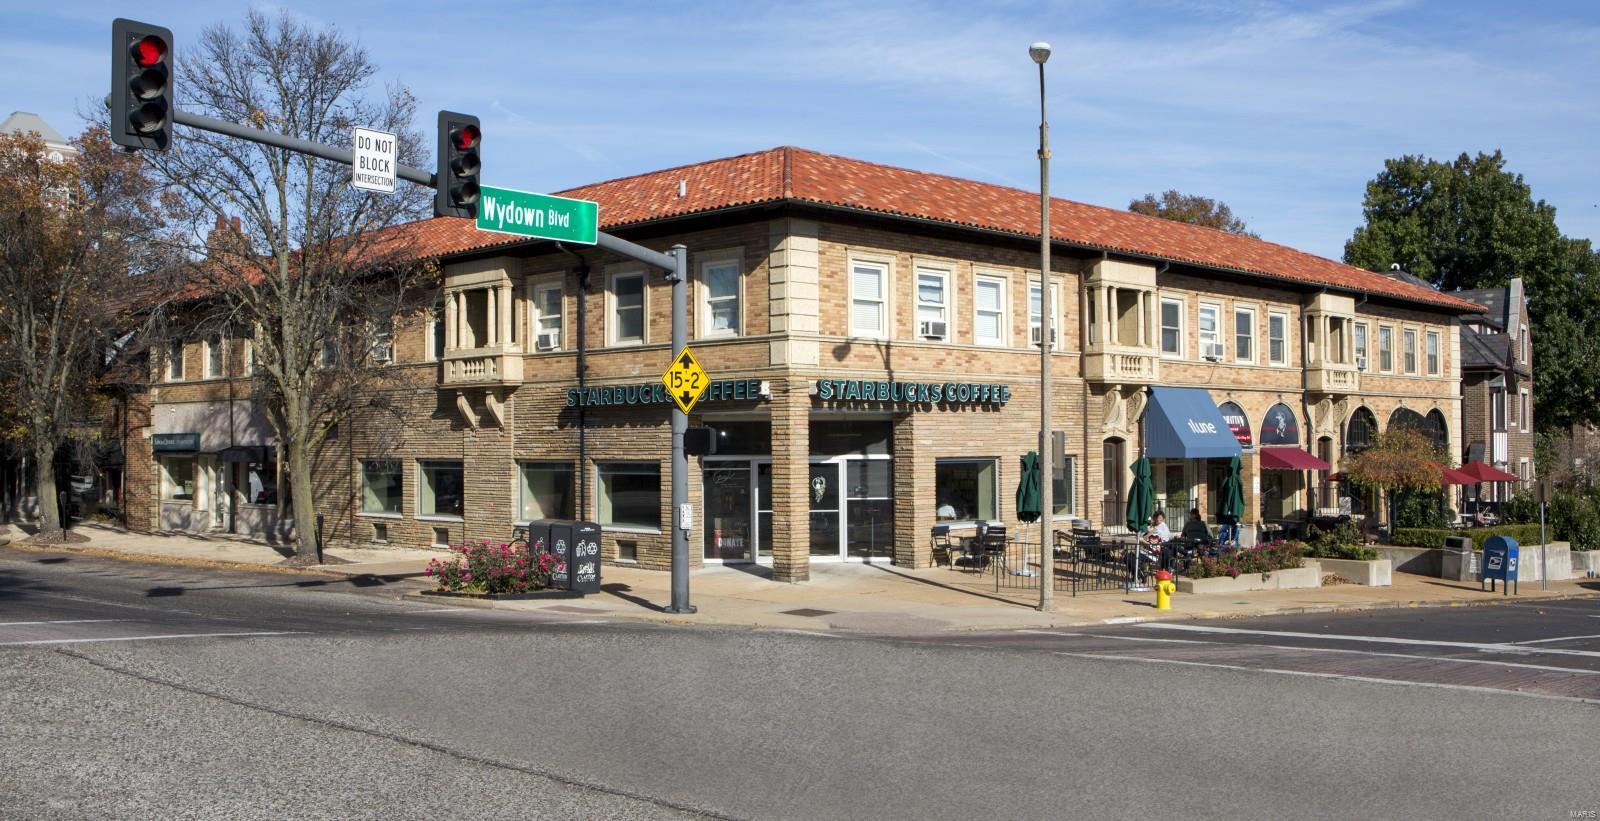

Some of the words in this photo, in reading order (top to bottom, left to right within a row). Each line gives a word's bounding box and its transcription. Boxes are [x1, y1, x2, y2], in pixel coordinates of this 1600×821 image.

[358, 135, 371, 150] DO
[375, 138, 393, 154] NOT
[360, 155, 390, 173] BLOCK
[355, 172, 394, 187] INTERSECTION
[483, 195, 545, 229] Wydown
[547, 209, 570, 228] Blvd
[669, 371, 700, 390] 15-2
[819, 378, 942, 402] STARBUCKS
[945, 382, 1010, 403] COFFEE
